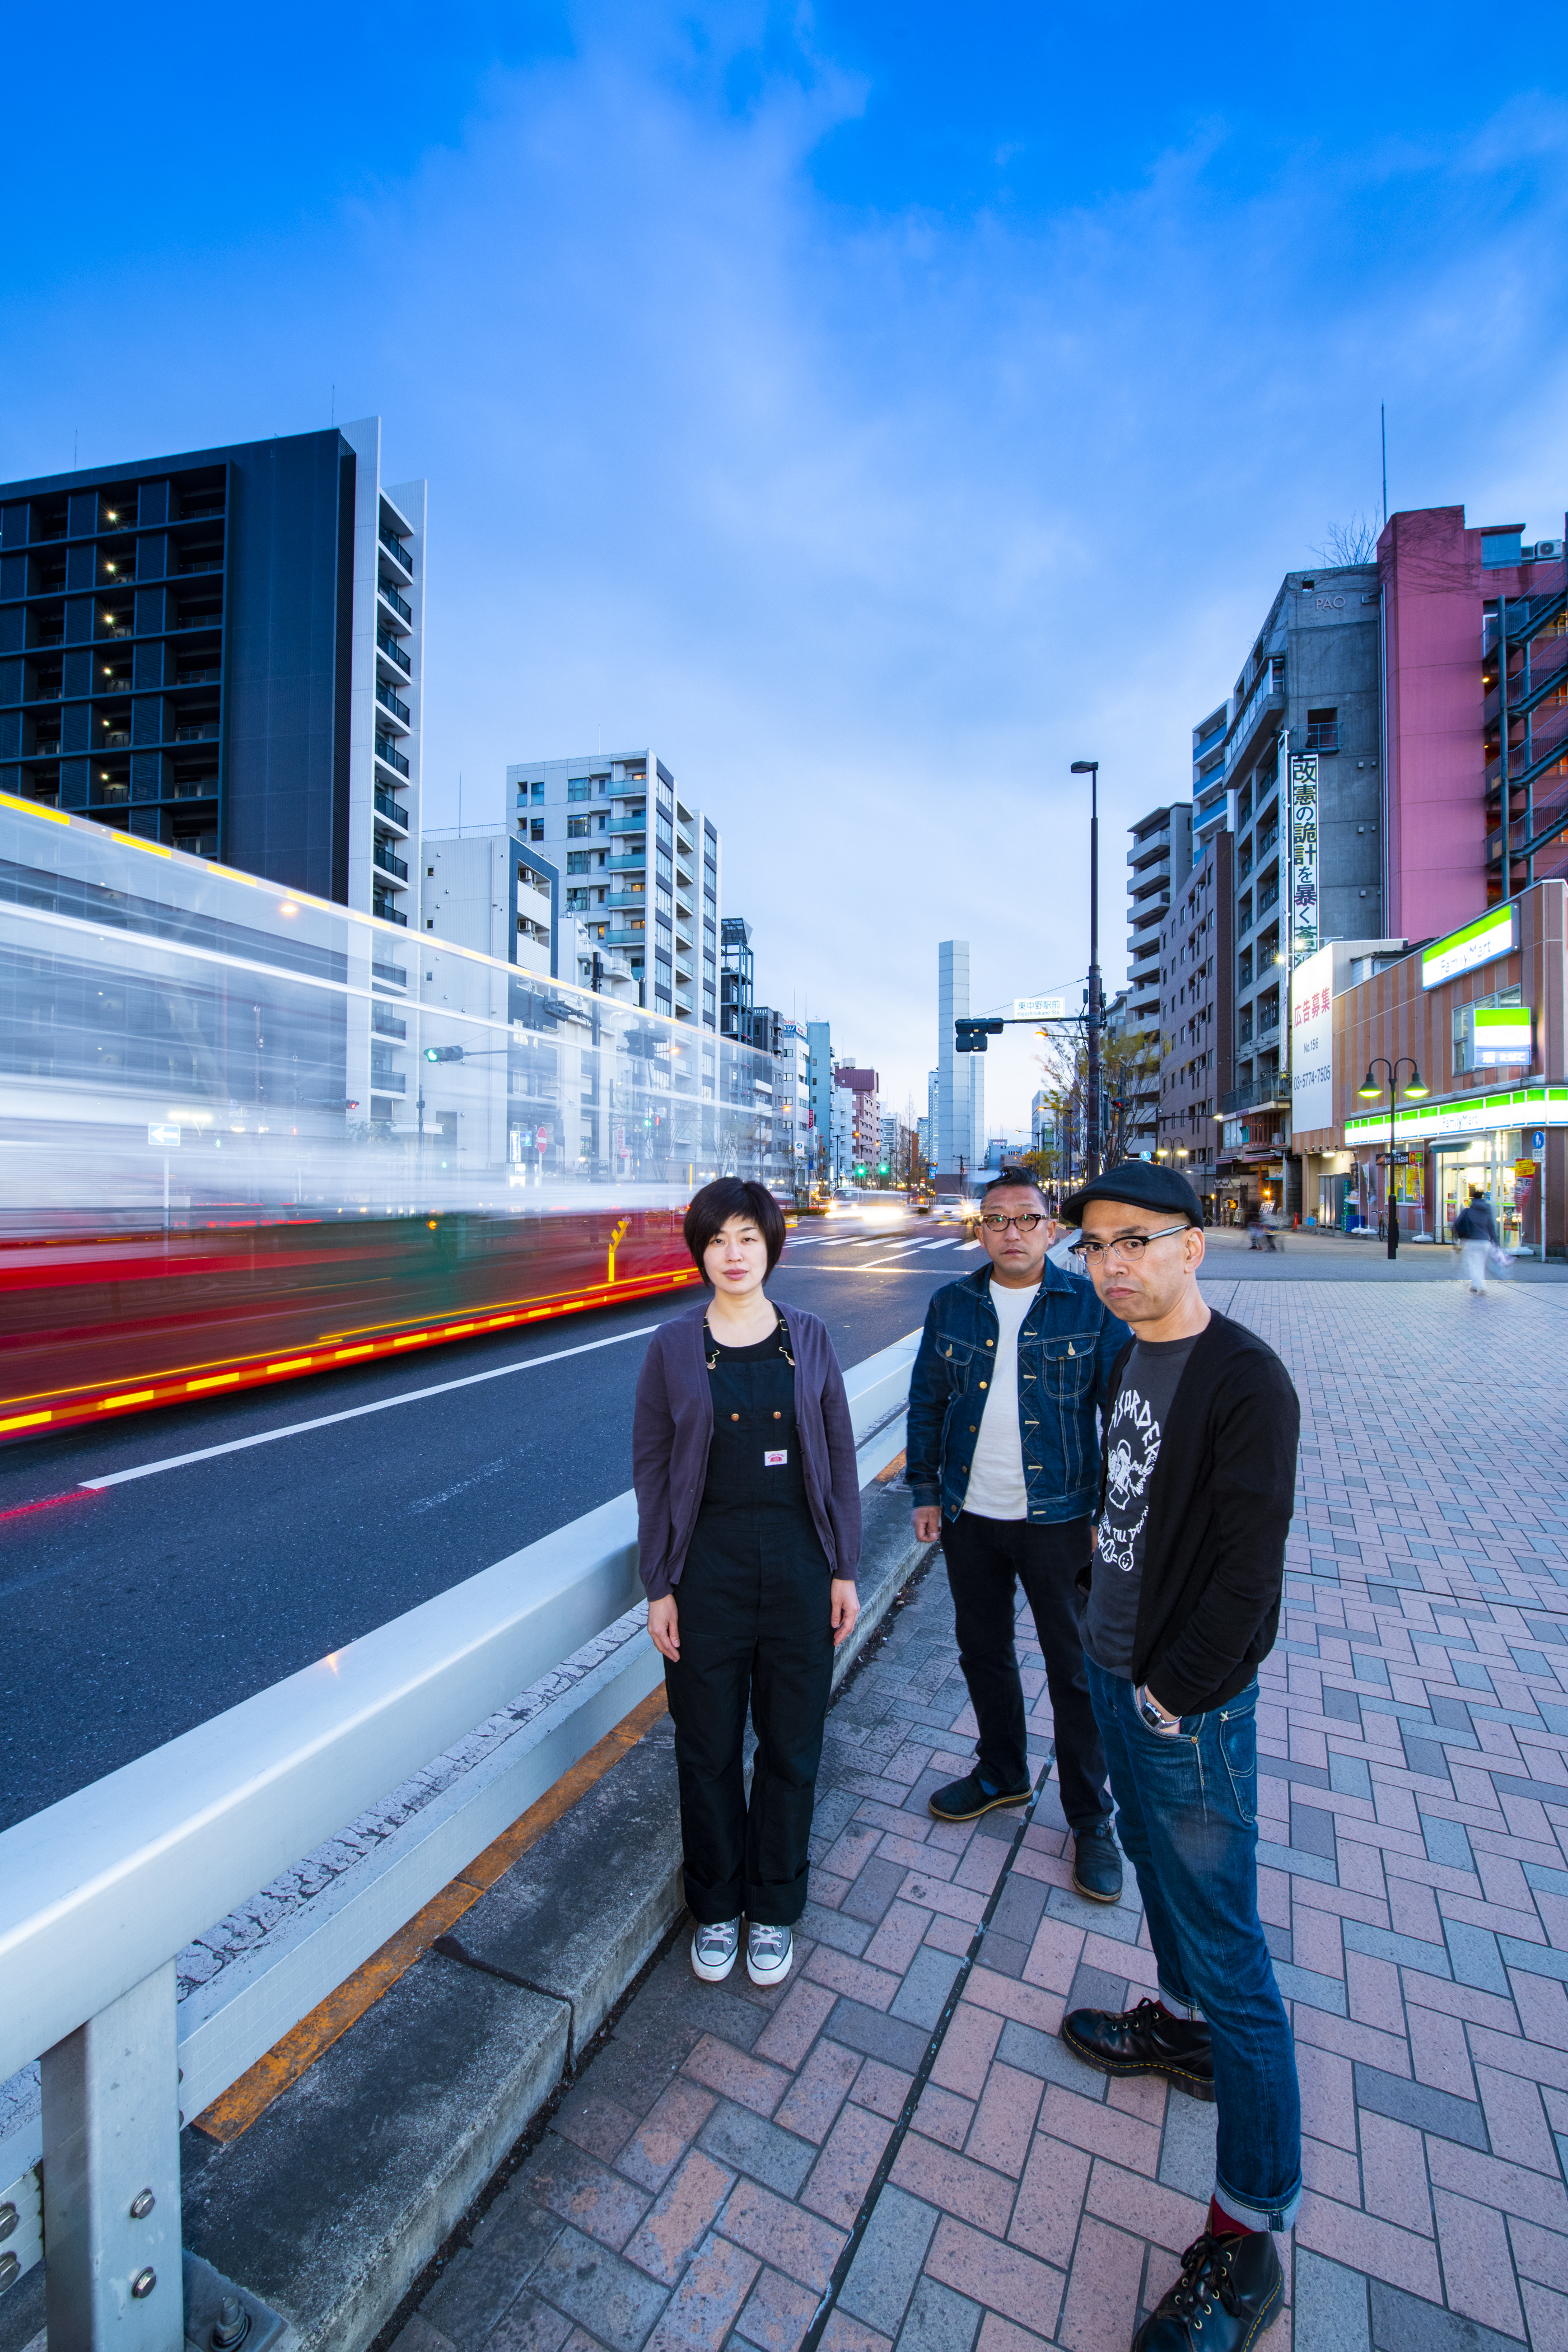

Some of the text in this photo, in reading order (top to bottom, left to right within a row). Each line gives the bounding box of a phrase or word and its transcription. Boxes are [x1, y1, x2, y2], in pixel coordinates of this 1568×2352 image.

[1316, 596, 1346, 611] PAO
[1440, 938, 1491, 976] FamilyMart
[1018, 1000, 1060, 1010] 東中野駅前
[1294, 987, 1331, 1029] 広告募集
[1304, 1037, 1319, 1054] No.156
[1499, 1052, 1526, 1062] たばこ
[1294, 1065, 1331, 1091] 03-5774-7505
[1442, 1114, 1478, 1130] FamilyMart
[1113, 1528, 1127, 1543] TILL
